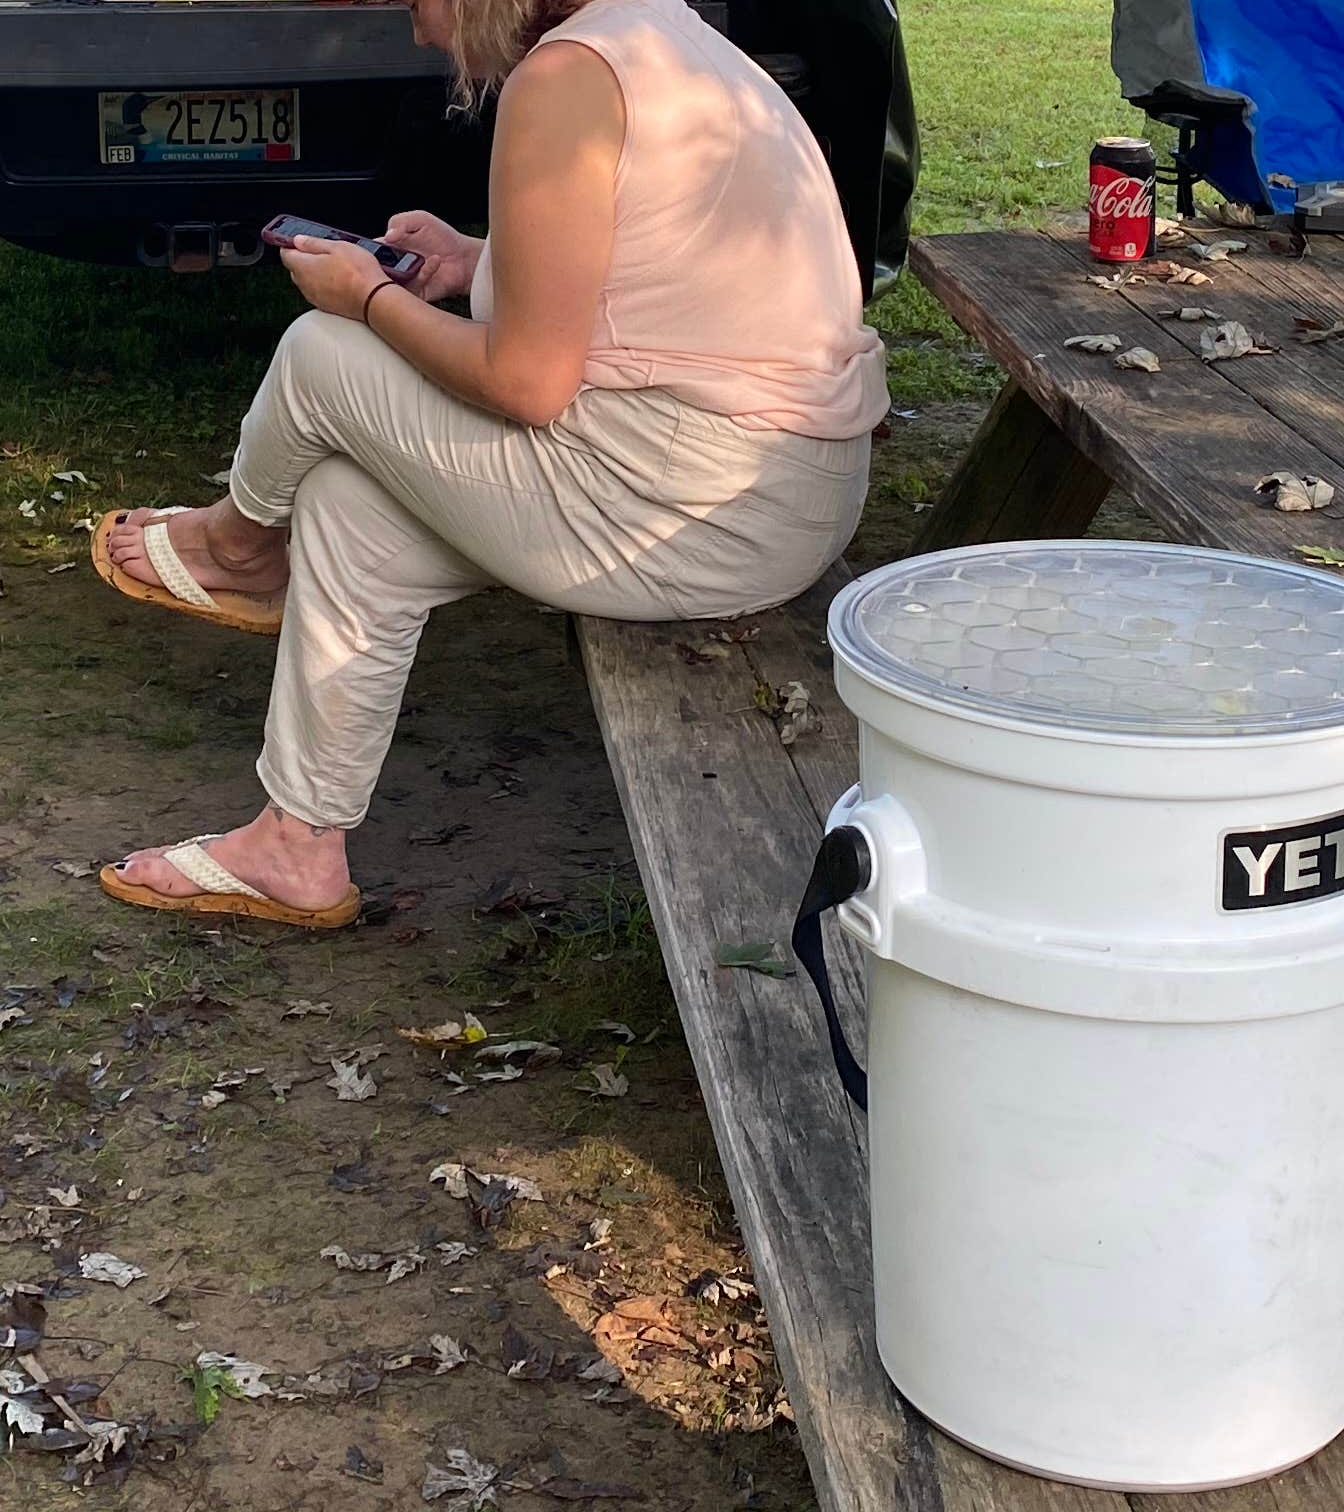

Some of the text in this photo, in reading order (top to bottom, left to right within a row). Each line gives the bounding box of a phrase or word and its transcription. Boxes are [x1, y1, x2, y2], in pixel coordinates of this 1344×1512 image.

[165, 99, 291, 145] 2EZ518
[109, 147, 132, 162] FEB
[1093, 219, 1116, 230] ero
